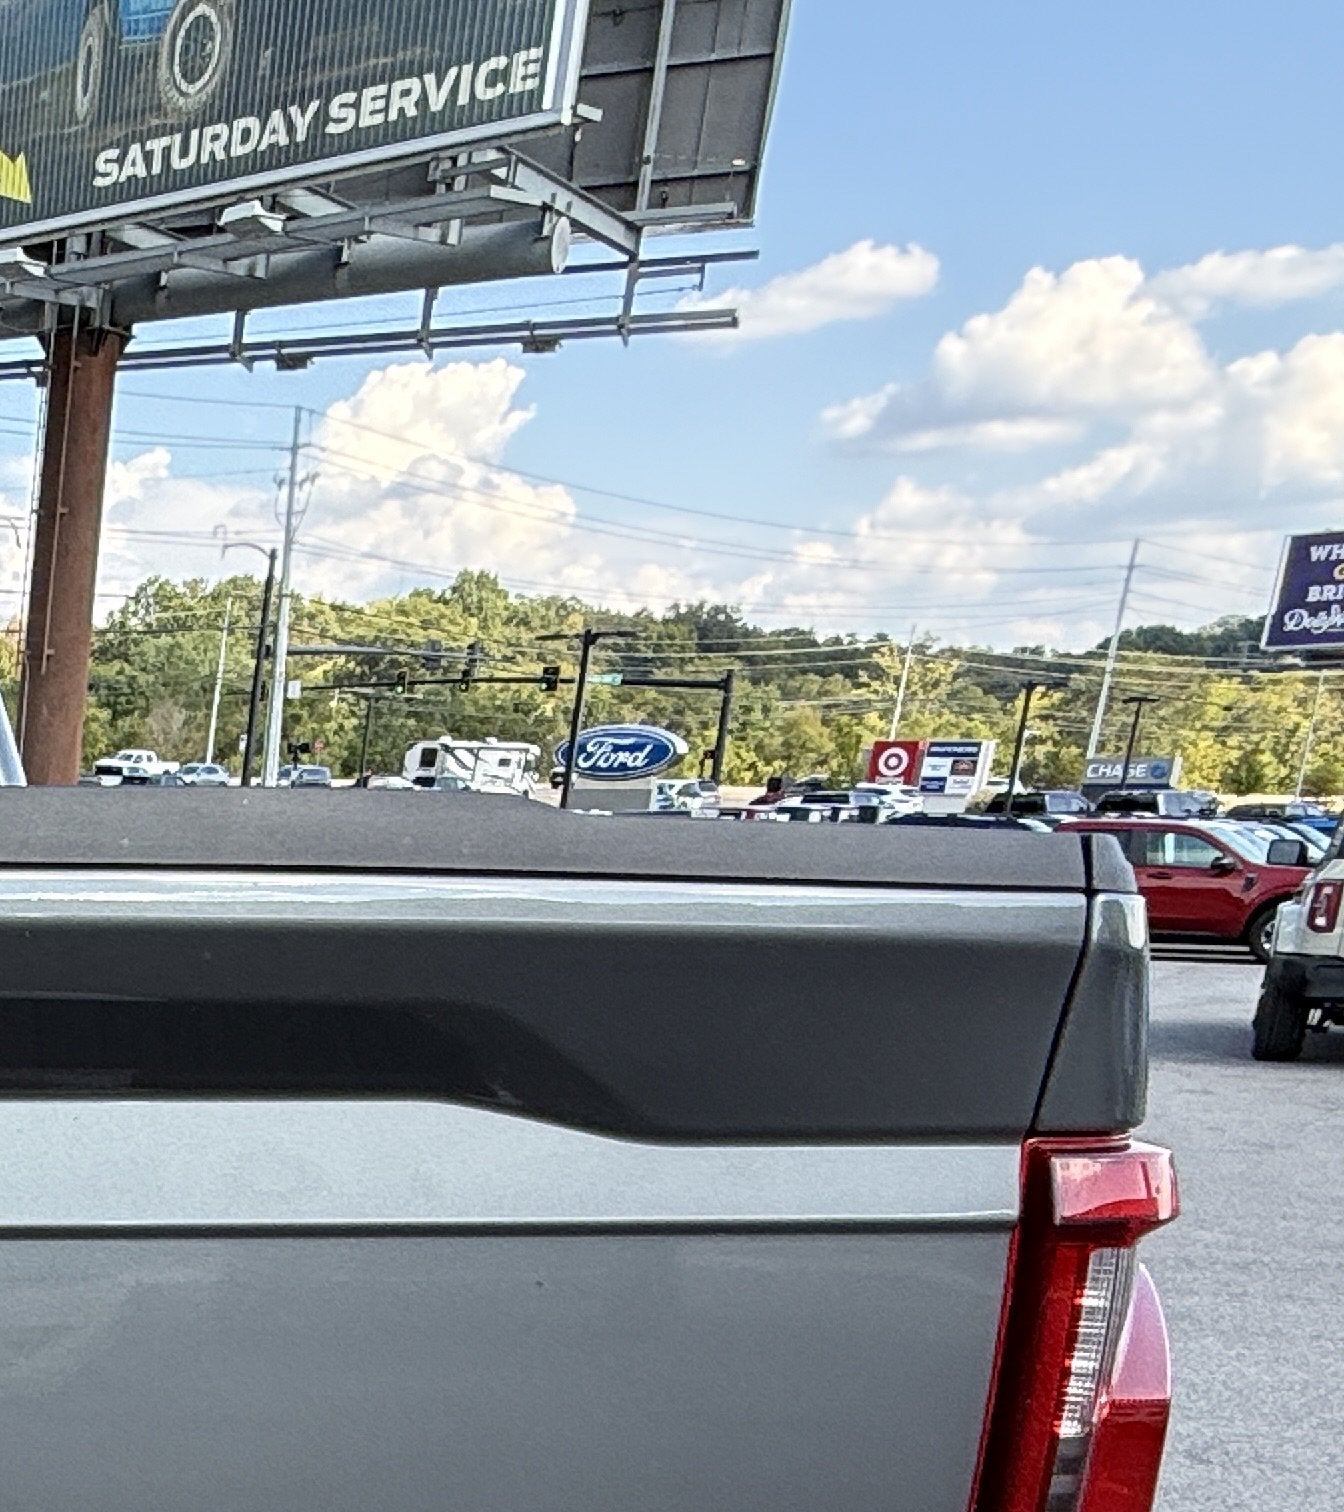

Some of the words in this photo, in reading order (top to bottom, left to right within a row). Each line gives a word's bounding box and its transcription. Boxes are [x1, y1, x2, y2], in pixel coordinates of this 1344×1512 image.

[92, 99, 321, 188] SATURDAY
[324, 46, 544, 135] SERVICE
[577, 736, 650, 769] Ford
